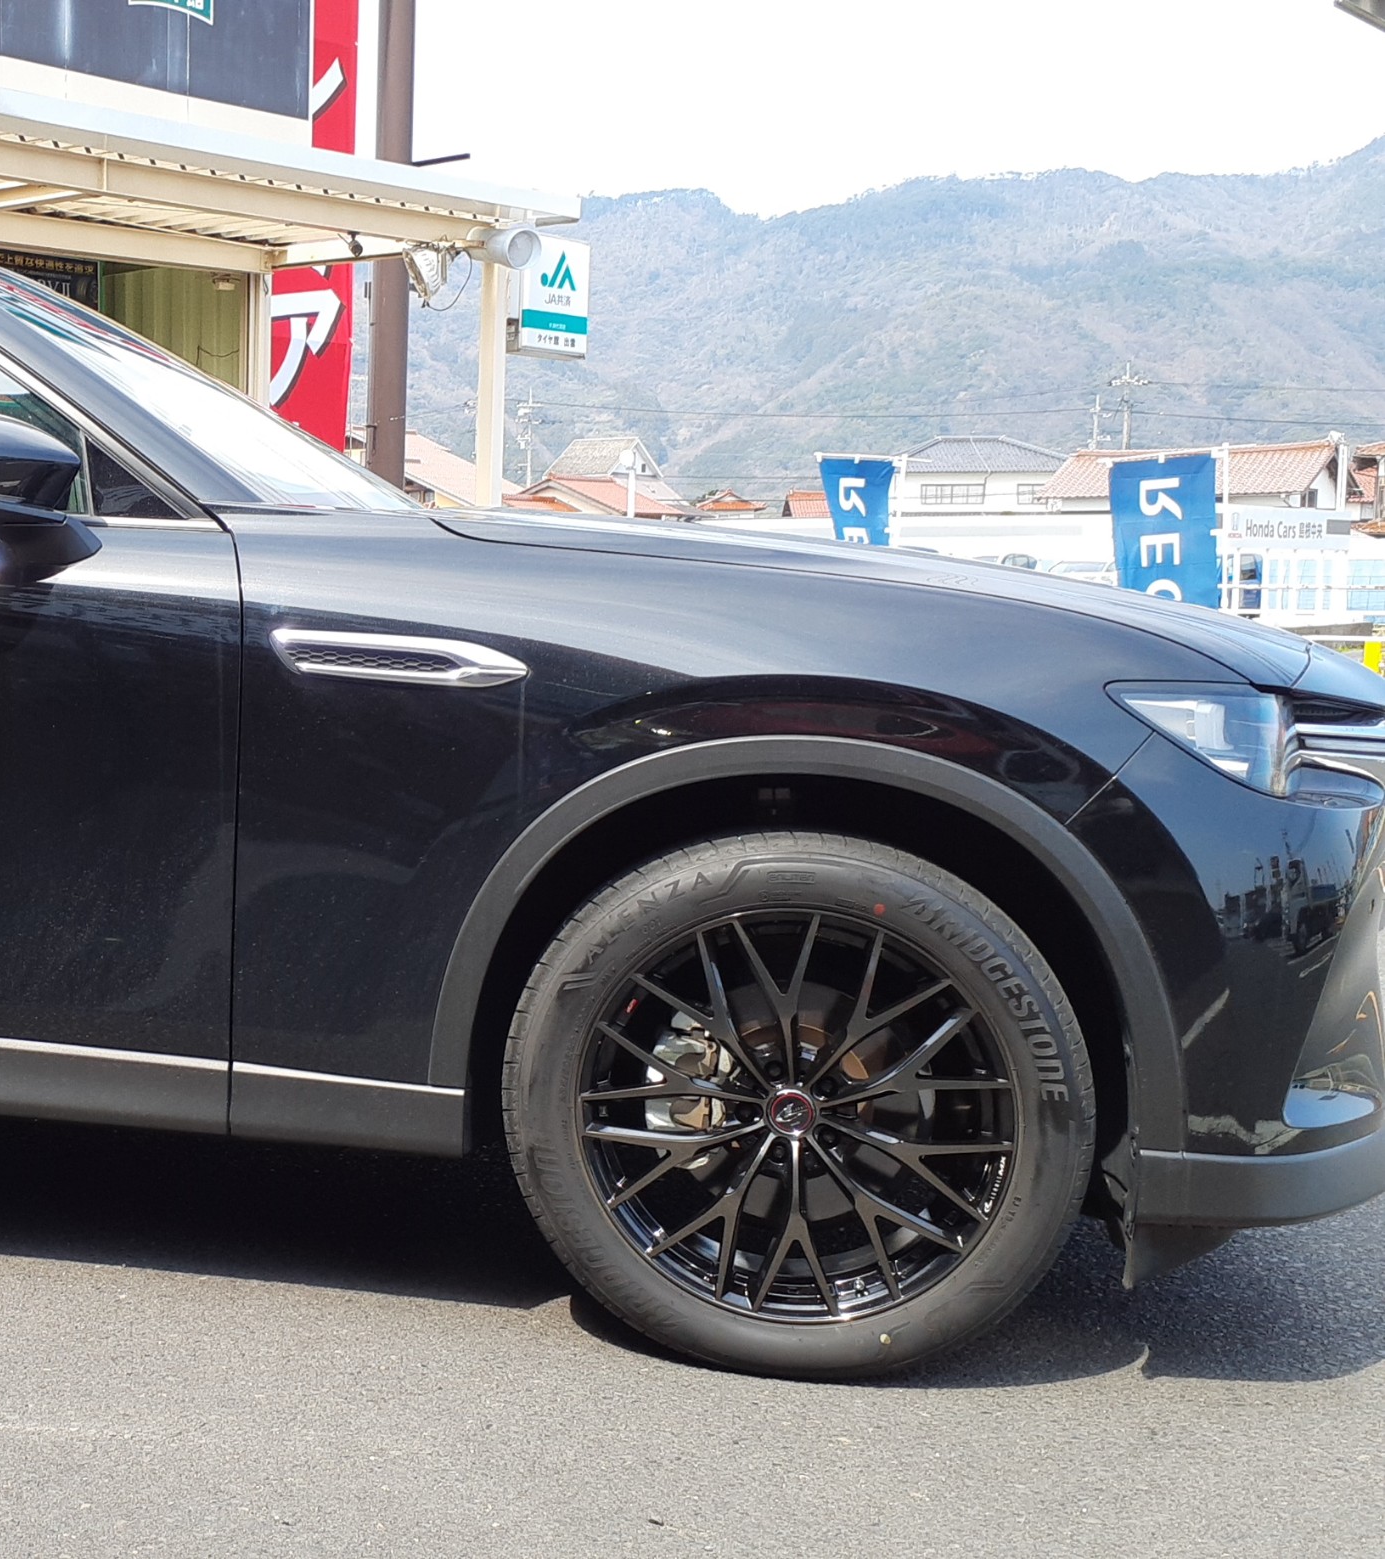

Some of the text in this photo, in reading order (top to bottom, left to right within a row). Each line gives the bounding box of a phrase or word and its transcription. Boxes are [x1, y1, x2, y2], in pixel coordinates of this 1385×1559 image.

[1245, 519, 1274, 538] Honda
[1277, 521, 1296, 539] Cars
[586, 871, 713, 965] ALENZA
[900, 896, 1070, 1102] BRIDGESTONE
